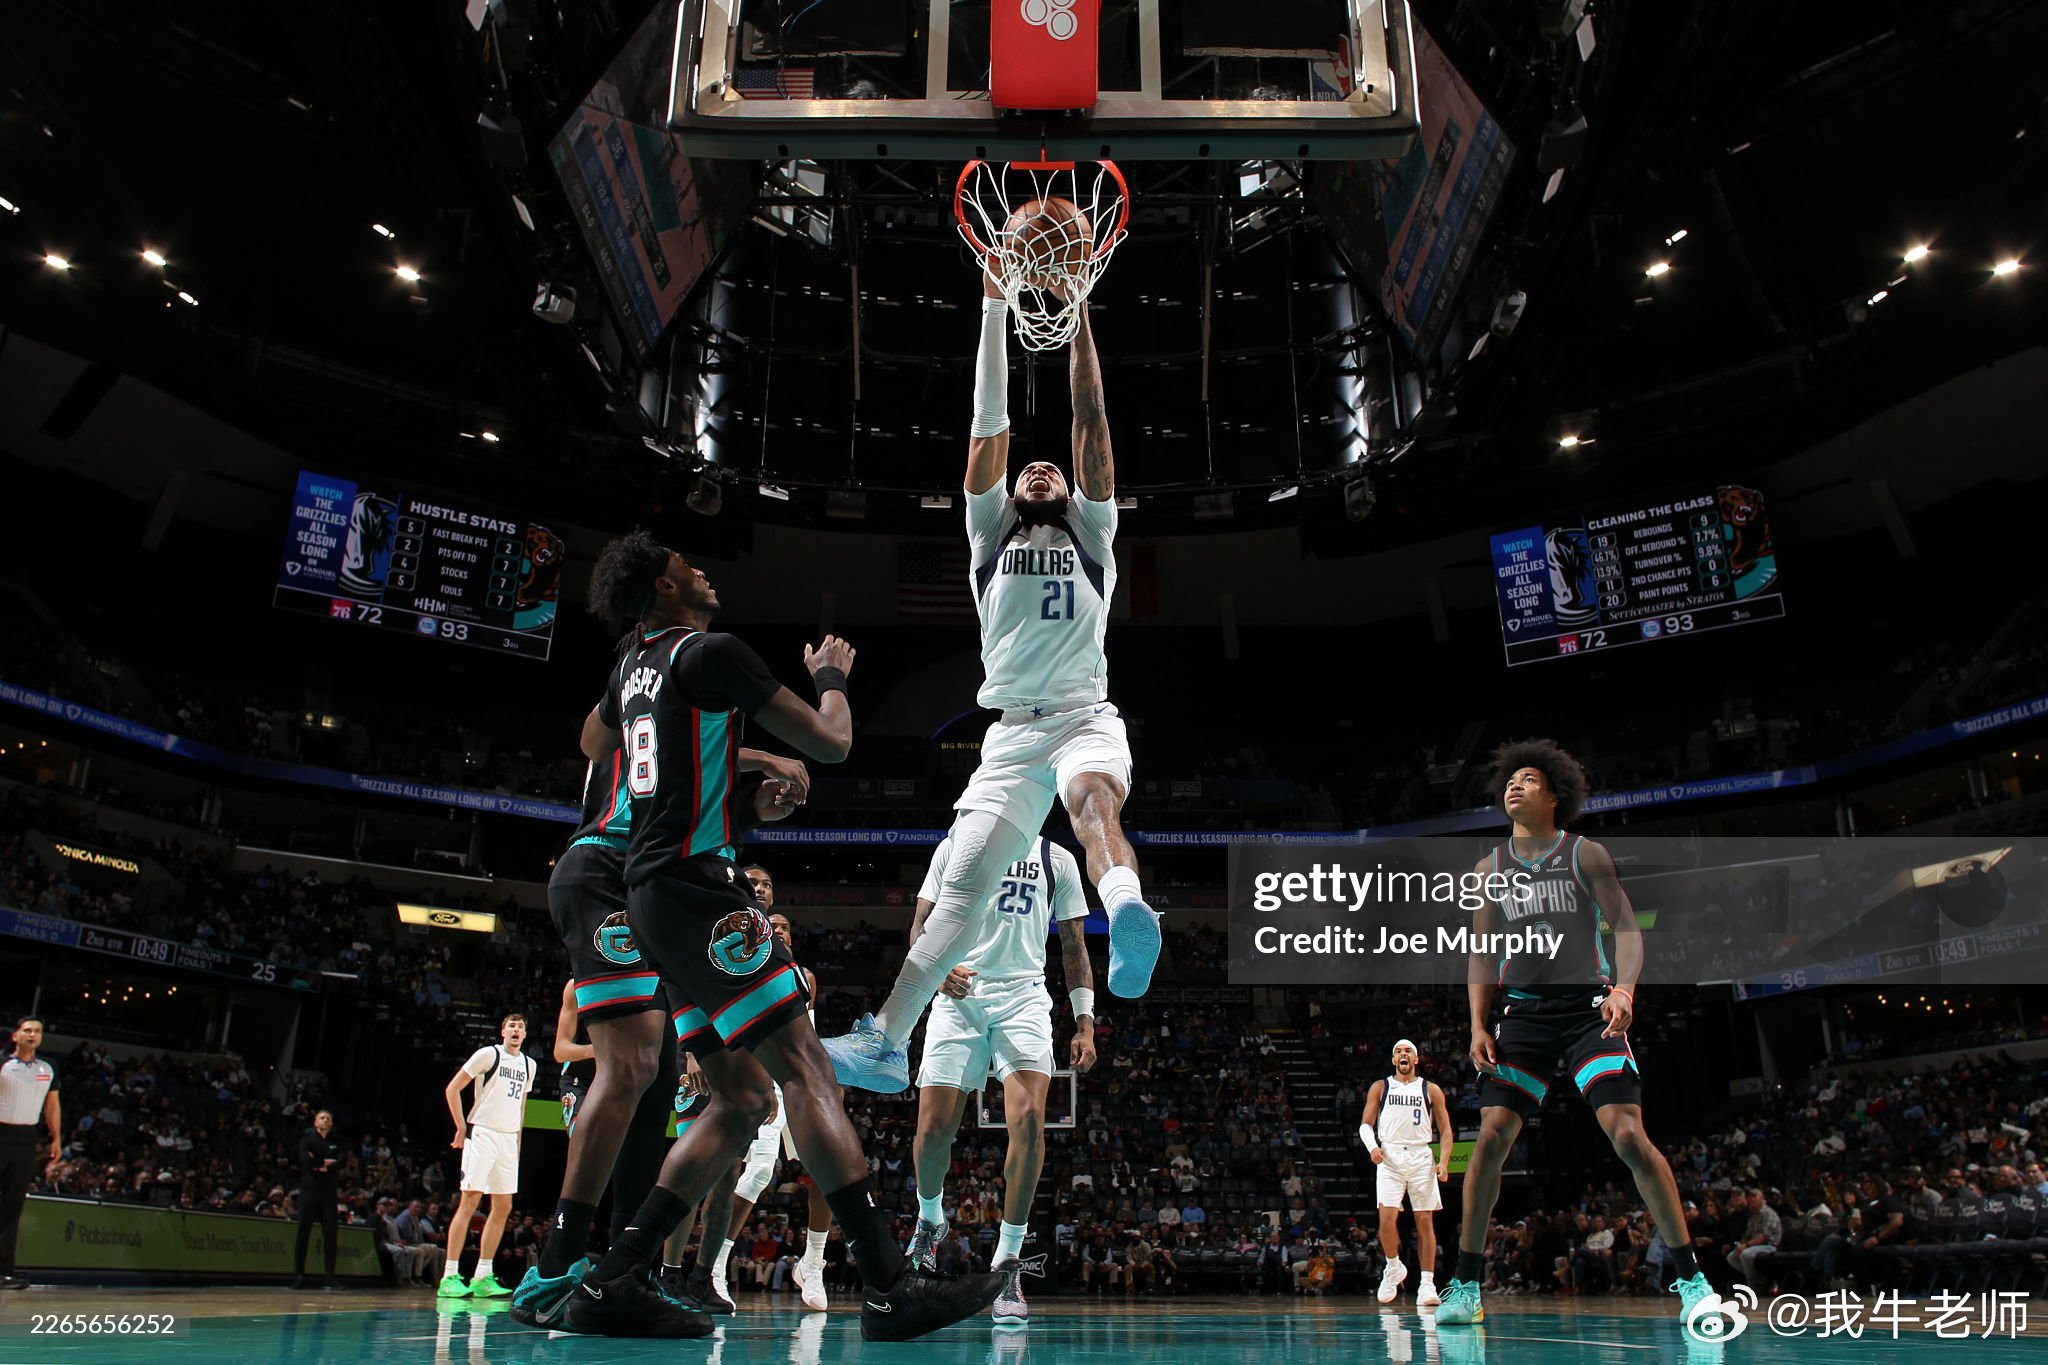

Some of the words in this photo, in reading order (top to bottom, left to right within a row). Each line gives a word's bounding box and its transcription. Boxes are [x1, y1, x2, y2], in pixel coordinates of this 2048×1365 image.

[1316, 91, 1337, 101] NBA
[310, 484, 343, 501] WATCH
[315, 497, 334, 510] THE
[1588, 510, 1647, 531] CLEANING
[1648, 504, 1673, 518] THE
[1673, 495, 1714, 513] GLASS
[296, 506, 347, 526] GRIZZLIES
[410, 501, 467, 524] HUSTLE
[469, 514, 517, 535] STATS
[309, 521, 328, 535] ALL
[407, 521, 414, 533] 5
[432, 528, 450, 539] FAST
[451, 532, 474, 544] BREAK
[474, 538, 488, 548] PTS
[505, 543, 512, 554] 2
[1597, 536, 1608, 548] 19
[1633, 523, 1673, 540] REBOUNDS
[1700, 515, 1708, 527] 9
[296, 531, 336, 549] SEASON
[1503, 538, 1533, 554] WATCH
[1642, 537, 1677, 553] REBOUND
[1677, 536, 1687, 546] %
[1695, 528, 1719, 543] 7.7%
[300, 545, 328, 560] LONG
[404, 539, 412, 550] 2
[438, 547, 451, 558] PTS
[452, 551, 466, 561] OFF
[467, 554, 477, 564] TO
[503, 560, 510, 571] 7
[1510, 550, 1529, 563] THE
[1634, 555, 1673, 570] TURNOVER
[1673, 552, 1683, 562] %
[303, 565, 336, 577] FANDUEL
[1002, 549, 1074, 576] DALLAS
[1498, 559, 1545, 578] GRIZZLIES
[401, 557, 408, 568] 4
[440, 566, 469, 580] STOCKS
[500, 578, 507, 589] 7
[1515, 574, 1532, 586] ALL
[1606, 581, 1614, 591] 11
[1631, 574, 1646, 587] 2ND
[1647, 569, 1676, 583] CHANCE
[1677, 566, 1692, 578] PTS
[1709, 560, 1716, 571] 0
[398, 575, 405, 586] 5
[440, 584, 463, 597] FOULS
[497, 595, 504, 606] 7
[1040, 580, 1075, 620] 21
[1507, 582, 1543, 599] SEASON
[1606, 595, 1620, 607] 20
[1638, 587, 1661, 601] PAINT
[1661, 582, 1689, 598] POINTS
[1711, 575, 1719, 587] 6
[413, 597, 446, 613] HHM
[1514, 595, 1539, 610] LONG
[357, 604, 383, 624] 72
[1522, 613, 1553, 624] FANDUEL
[440, 621, 469, 640] 93
[1665, 614, 1695, 634] 93
[1580, 630, 1608, 649] 72
[621, 666, 663, 713] PROSPER
[18, 690, 45, 709] LONG
[48, 700, 63, 714] ON
[81, 711, 129, 734] FANDUEL
[2011, 704, 2031, 720] ALL
[941, 742, 955, 750] BIG
[957, 742, 980, 750] RIVER
[403, 786, 420, 798] ALL
[421, 788, 457, 803] SEASON
[457, 794, 482, 807] LONG
[483, 798, 496, 809] ON
[513, 803, 556, 818] FANDUEL
[1591, 795, 1627, 809] SEASON
[1627, 791, 1652, 805] LONG
[1653, 790, 1667, 801] ON
[1686, 782, 1734, 795] FANDUEL
[799, 832, 813, 841] ALL
[815, 831, 847, 842] SEASON
[848, 832, 870, 842] LONG
[871, 832, 883, 842] ON
[900, 833, 940, 841] FANDUEL
[1185, 833, 1199, 844] ALL
[1201, 833, 1233, 844] SEASON
[1234, 833, 1255, 844] LONG
[1256, 833, 1268, 844] ON
[1286, 836, 1327, 844] FANDUEL
[94, 853, 139, 873] MINOLTA
[998, 881, 1037, 915] 25
[1498, 880, 1577, 922] MEMPHIS
[50, 932, 58, 942] 0
[69, 924, 77, 934] 7
[131, 937, 169, 961] 10:49
[1929, 939, 1968, 965] 10:49
[252, 962, 277, 982] 25
[1781, 970, 1807, 990] 36
[499, 1066, 526, 1082] DALLAS
[507, 1081, 523, 1100] 32
[1388, 1094, 1422, 1107] DALLAS
[1413, 1109, 1421, 1126] 9
[79, 1224, 142, 1248] Robinhood
